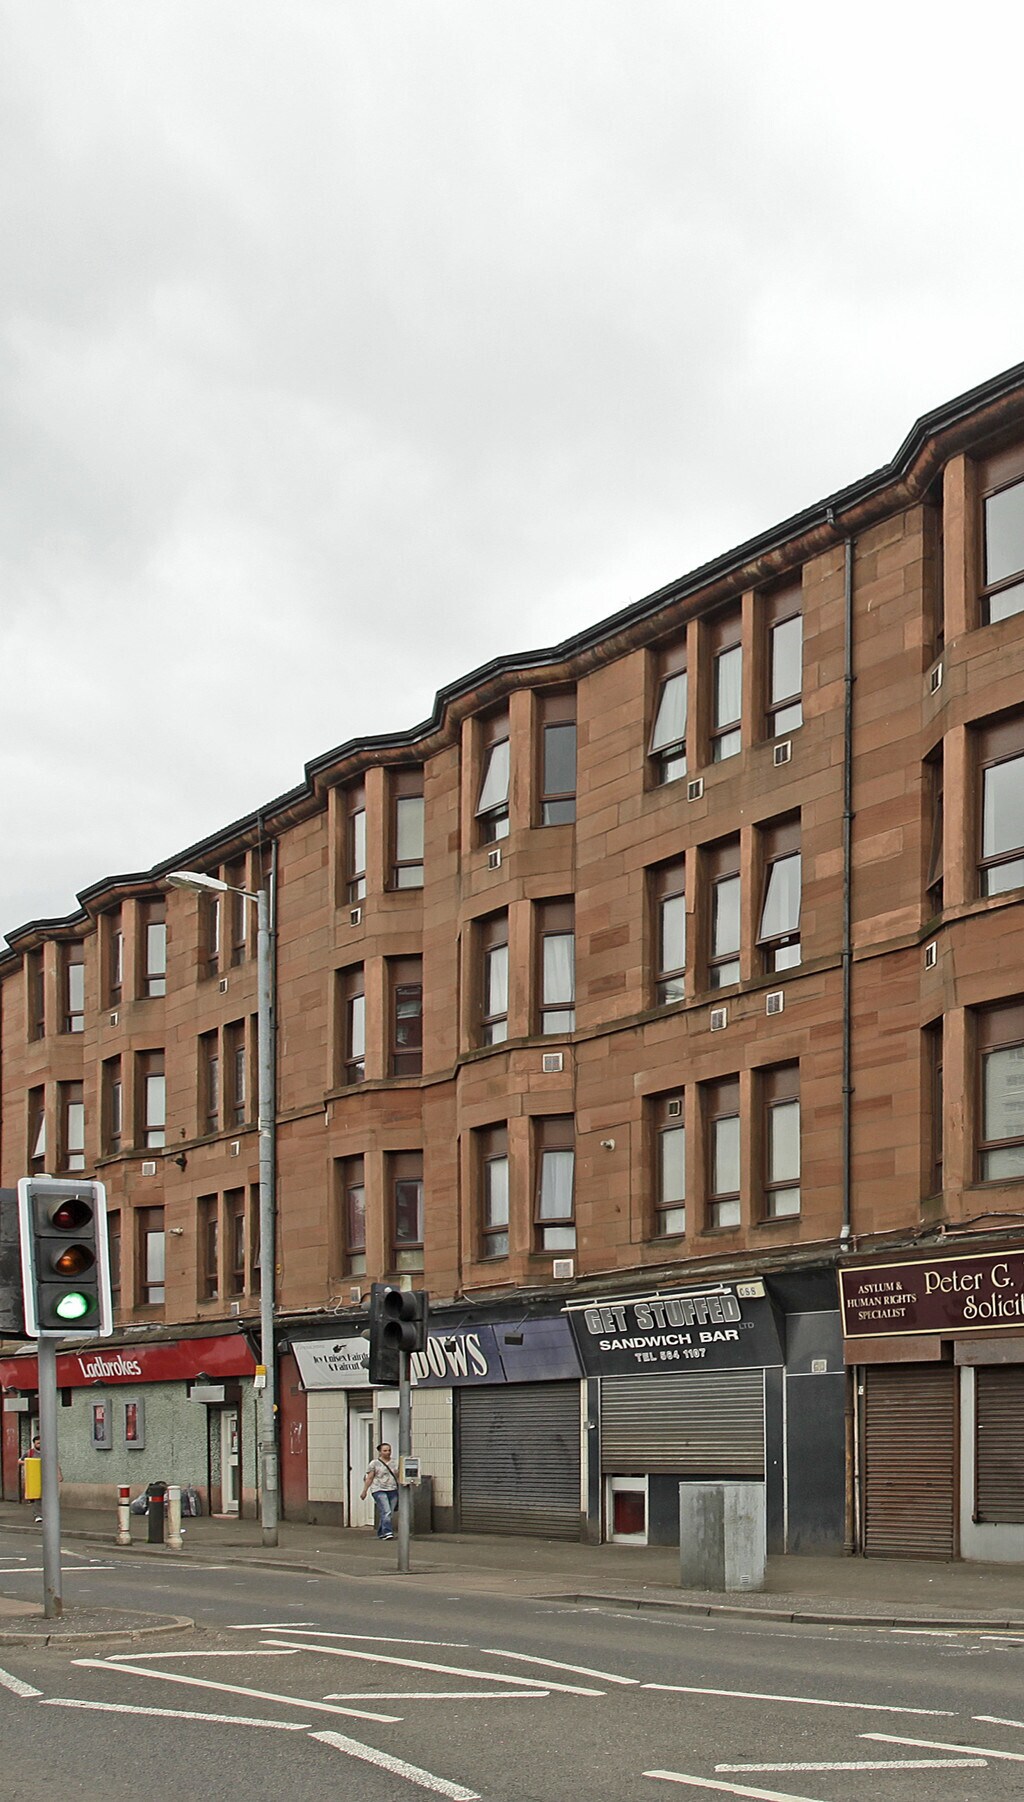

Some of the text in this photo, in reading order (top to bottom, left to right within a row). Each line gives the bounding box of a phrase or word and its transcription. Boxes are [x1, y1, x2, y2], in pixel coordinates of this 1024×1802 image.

[924, 1270, 983, 1294] Peter
[991, 1264, 1014, 1288] G.
[858, 1281, 903, 1295] ASYLUM &
[847, 1293, 917, 1308] HUMAN RIGHTS
[584, 1295, 742, 1335] GET STUFFED
[858, 1307, 906, 1320] SPECIALIST
[739, 1321, 754, 1330] LTD
[599, 1329, 739, 1351] SANDWICH BAR
[635, 1352, 657, 1362] TEL
[78, 1356, 142, 1378] Ladbrokes
